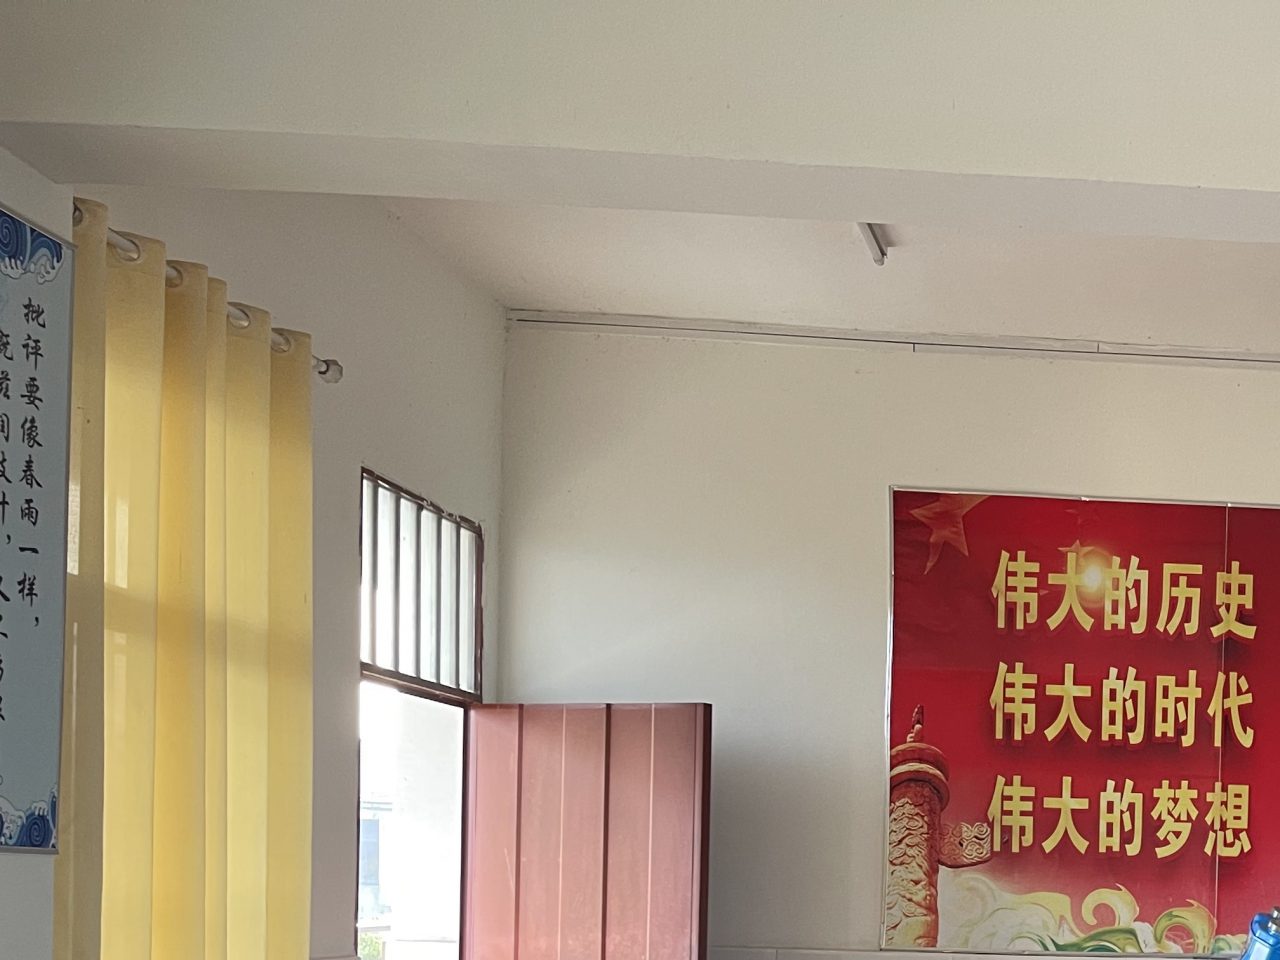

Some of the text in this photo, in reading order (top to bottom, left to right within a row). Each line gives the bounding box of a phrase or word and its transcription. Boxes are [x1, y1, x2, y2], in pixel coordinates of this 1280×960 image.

[989, 550, 1257, 639] 伟大的历史
[990, 661, 1254, 748] 伟大的时代
[987, 775, 1251, 858] 伟大的梦想
